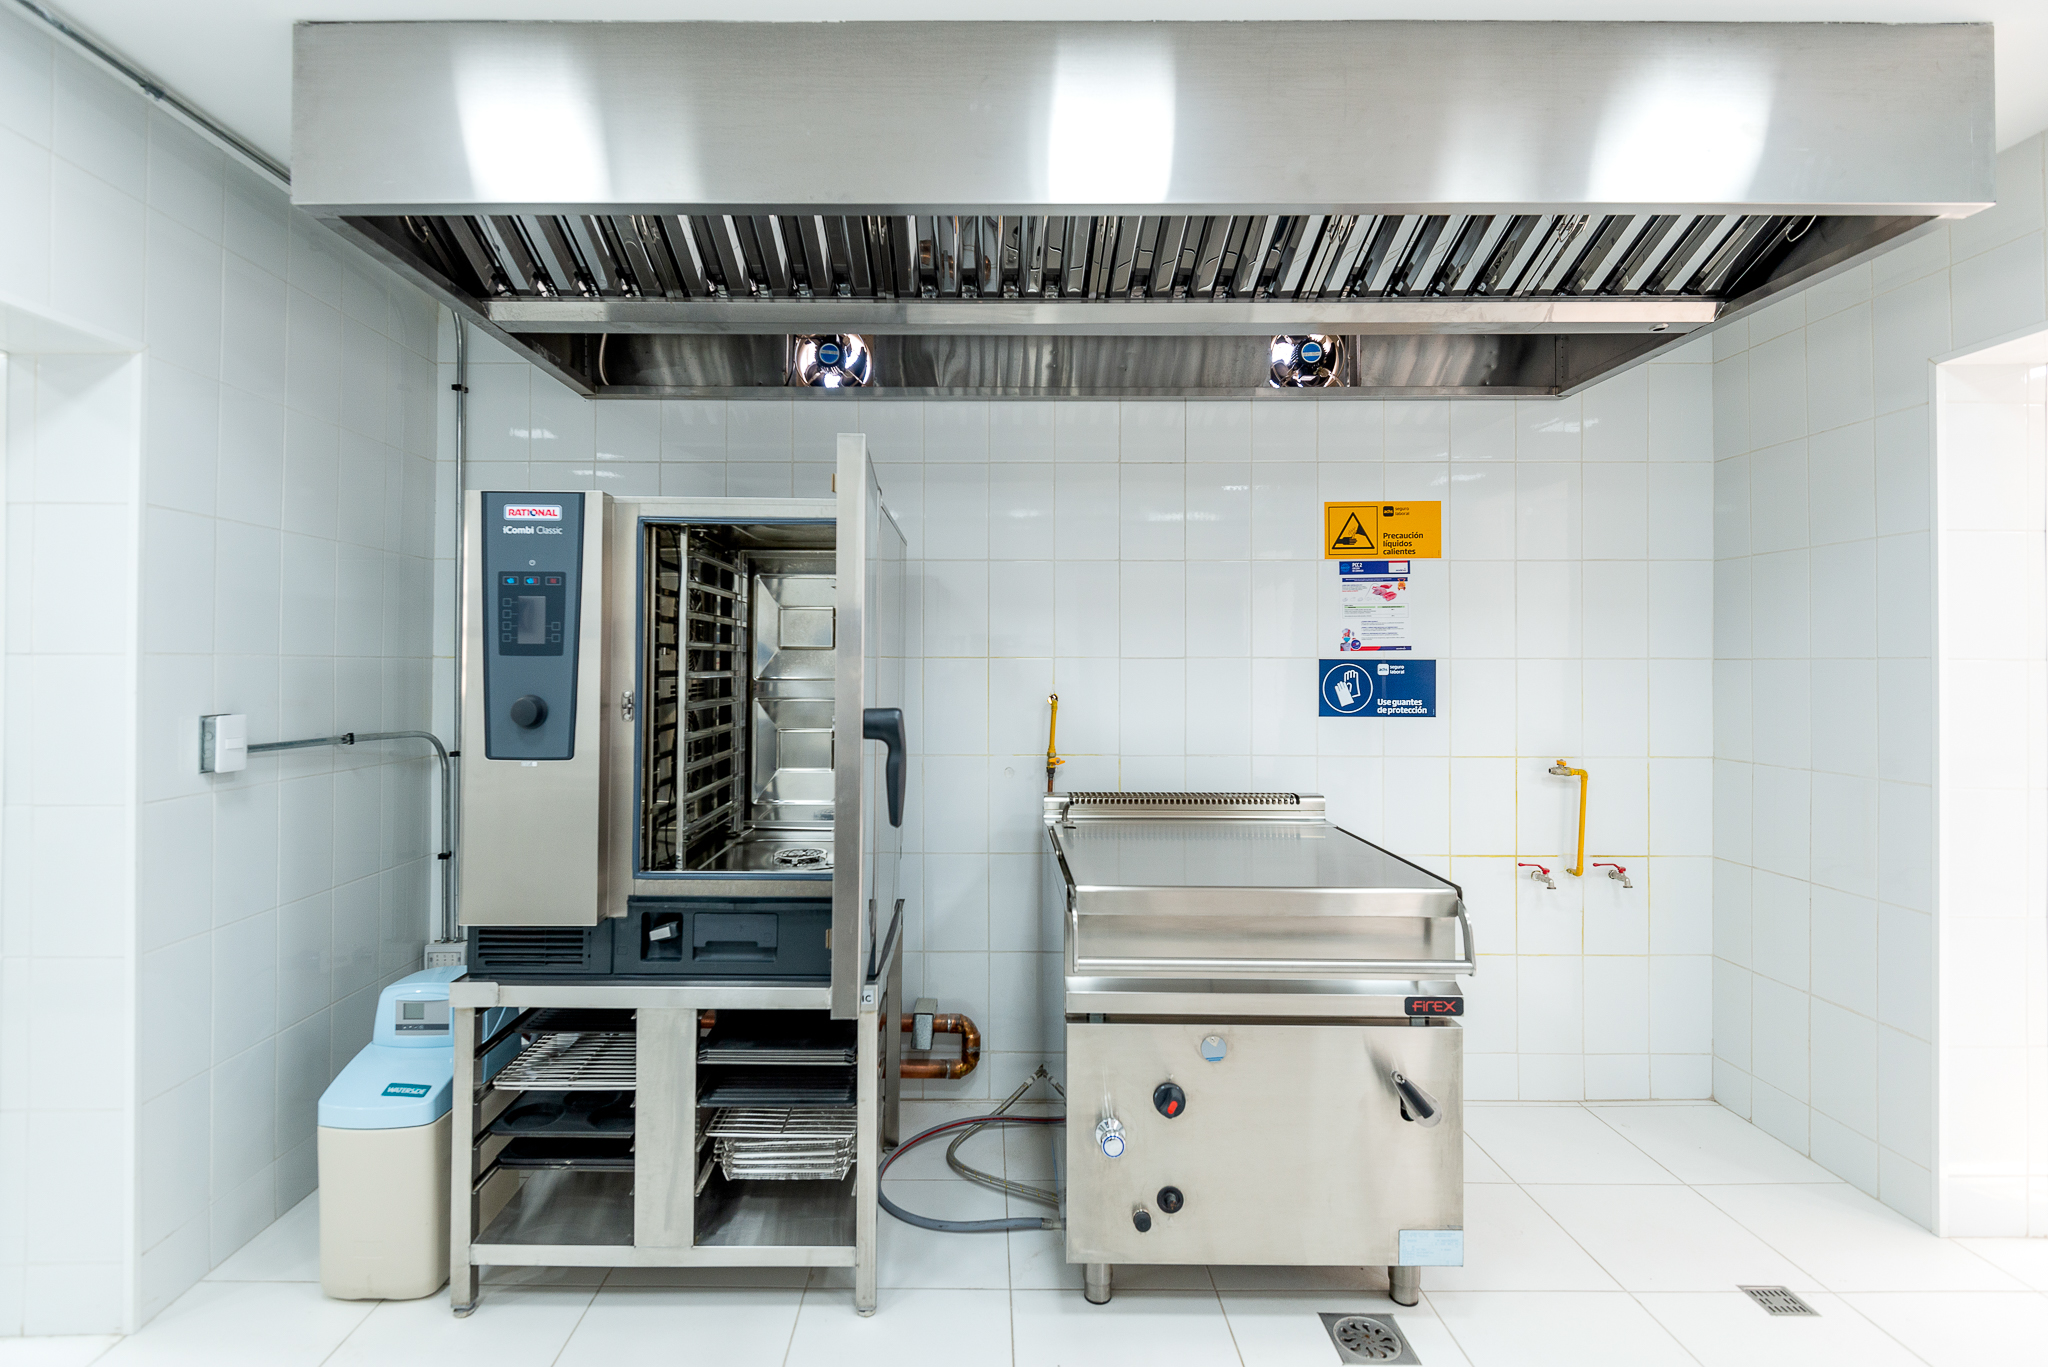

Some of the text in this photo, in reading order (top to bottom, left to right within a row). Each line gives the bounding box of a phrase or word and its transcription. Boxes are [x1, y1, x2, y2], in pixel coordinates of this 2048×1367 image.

[508, 508, 558, 517] RATIONAL
[502, 526, 563, 535] iCombi Classic
[1383, 540, 1413, 548] líquidos
[1377, 698, 1422, 708] Use guantes
[1377, 706, 1387, 714] de
[1387, 706, 1428, 715] protección
